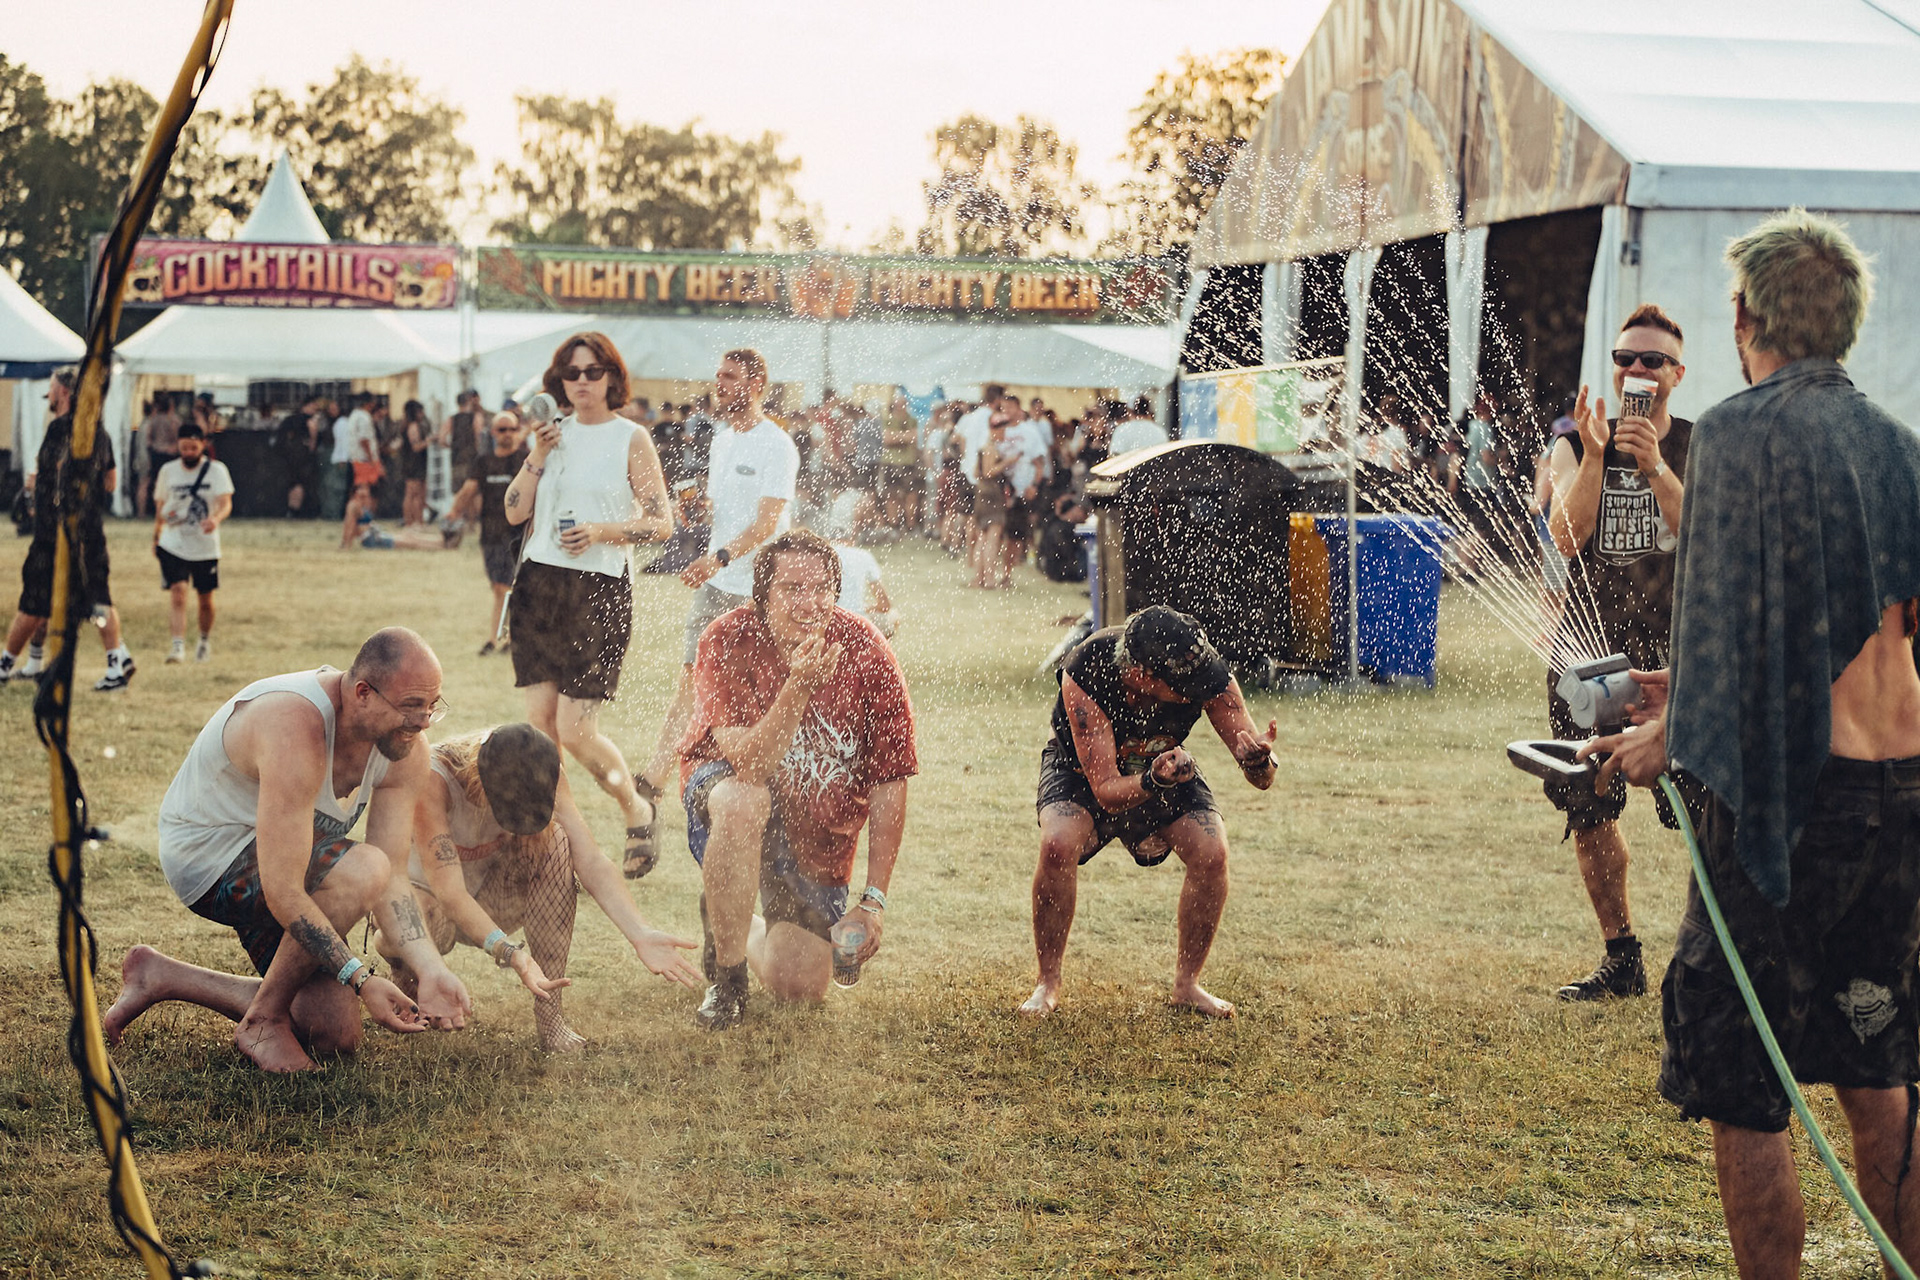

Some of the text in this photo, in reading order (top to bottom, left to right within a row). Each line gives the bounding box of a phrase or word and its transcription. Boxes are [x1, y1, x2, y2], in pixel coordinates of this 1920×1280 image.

[163, 247, 396, 302] COCKTAILS
[542, 259, 782, 301] MIGHTY BEER
[1009, 271, 1103, 310] BEER
[1606, 494, 1650, 508] SUPPORT
[1606, 507, 1651, 518] YOUR LOCAL
[1605, 516, 1651, 533] MUSIC
[1604, 532, 1651, 550] SCENE
